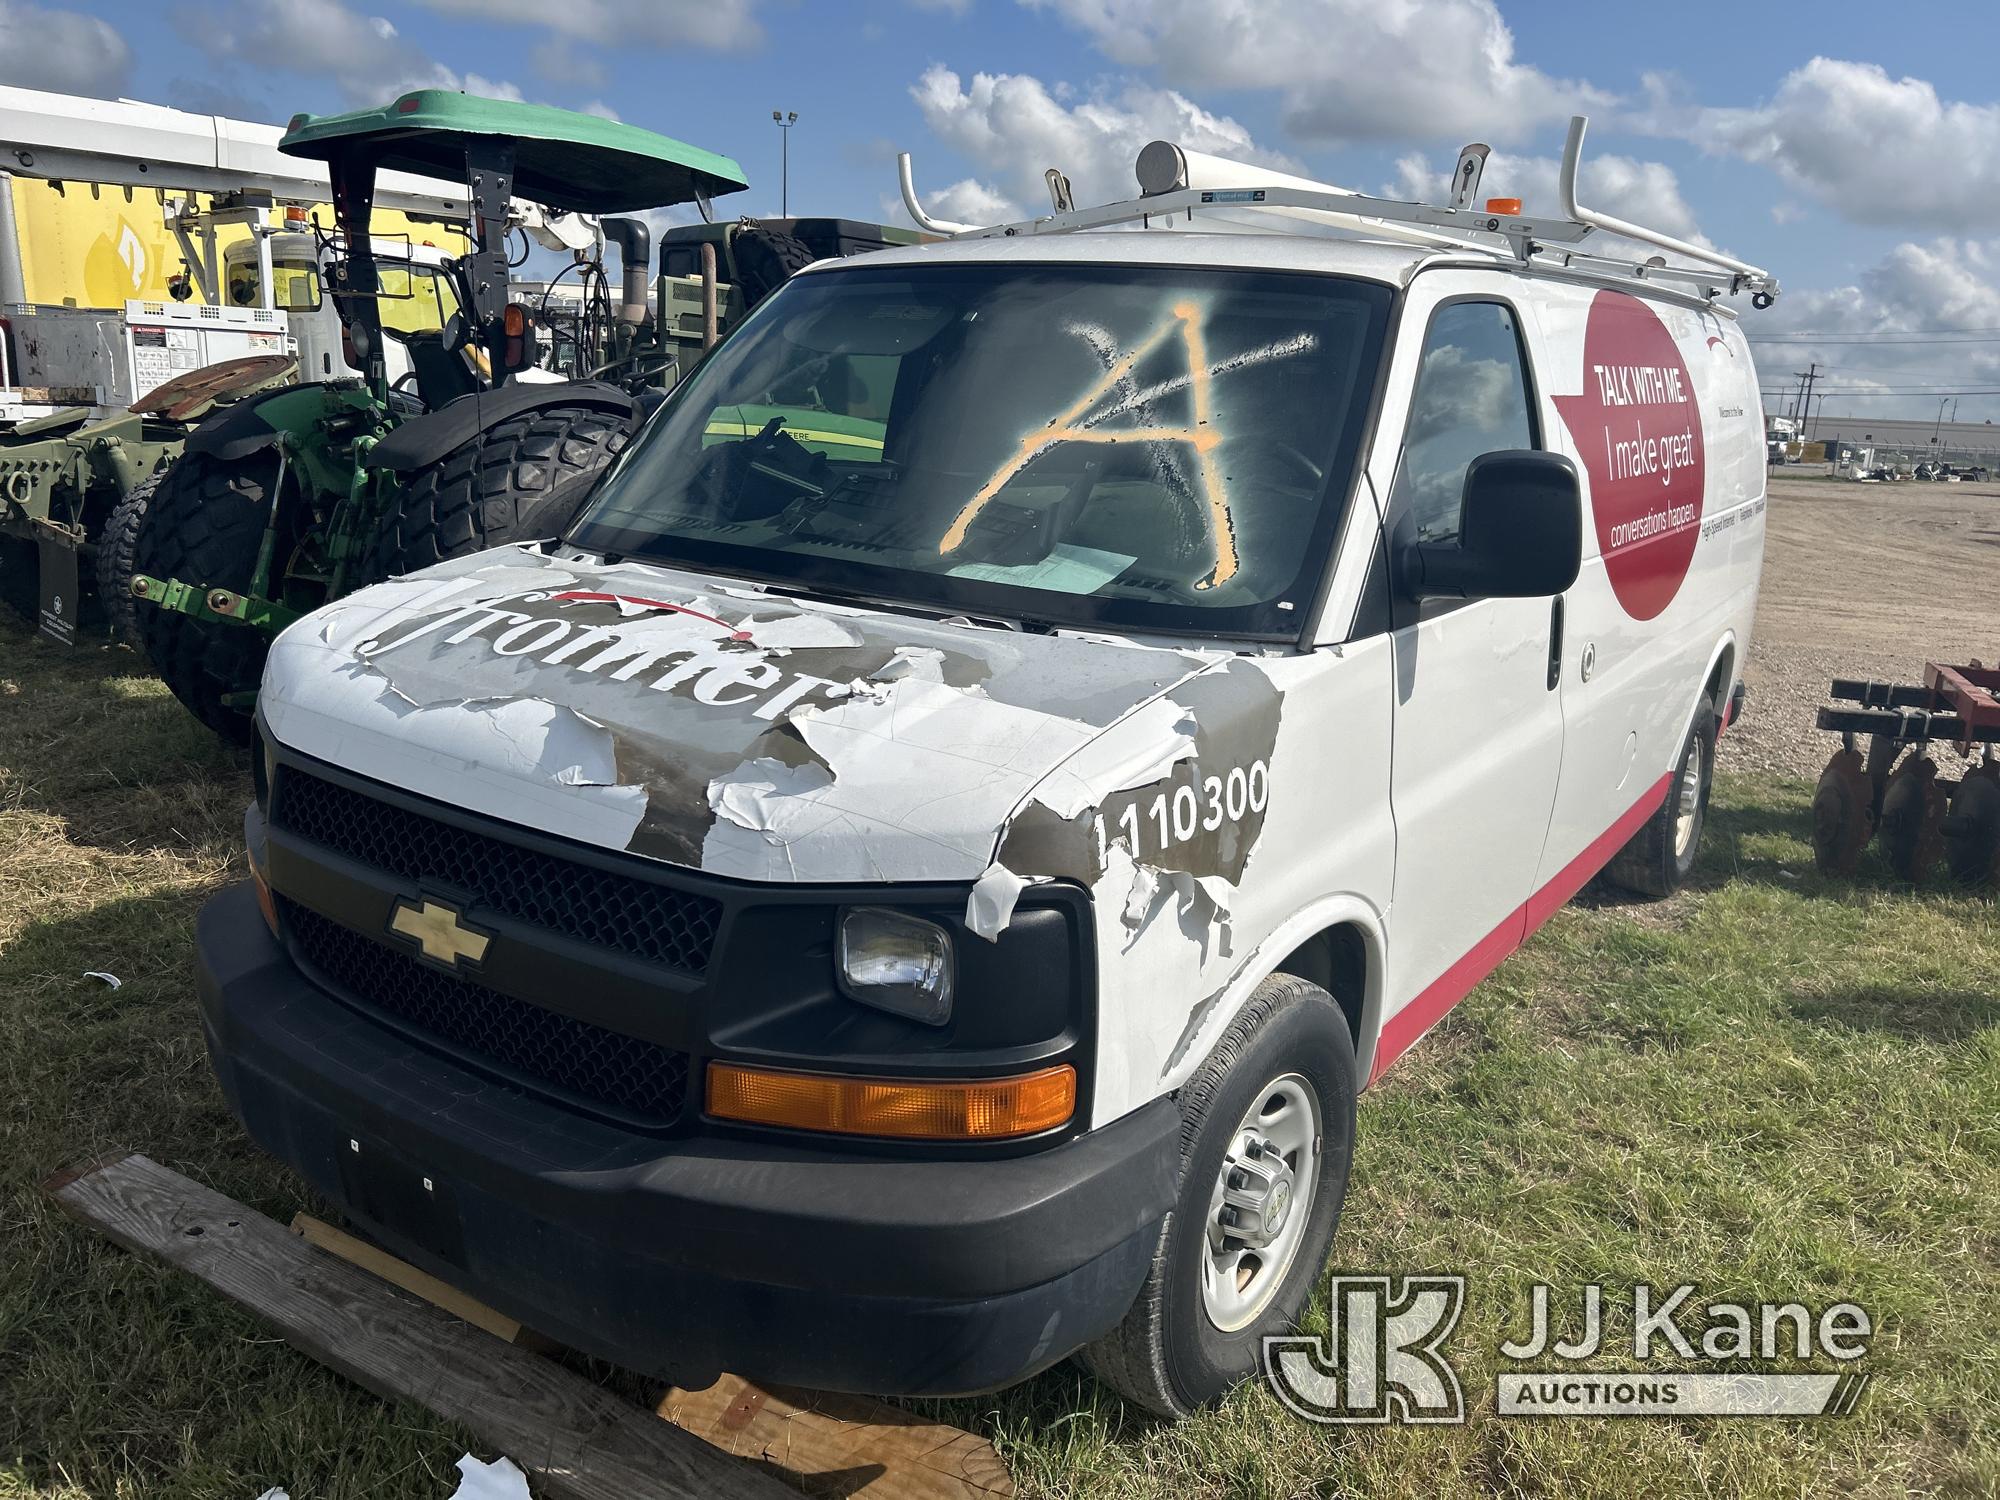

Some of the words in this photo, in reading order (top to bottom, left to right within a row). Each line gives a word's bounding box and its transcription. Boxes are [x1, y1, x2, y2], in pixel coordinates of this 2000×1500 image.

[1594, 365, 1633, 406] TALK
[1631, 366, 1665, 405] WITH
[1663, 367, 1687, 403] ME.
[940, 302, 1238, 590] A
[1605, 425, 1613, 481] I
[1615, 420, 1657, 480] make
[1660, 425, 1695, 486] great
[1611, 507, 1666, 547] conversations
[1667, 500, 1696, 532] happen.
